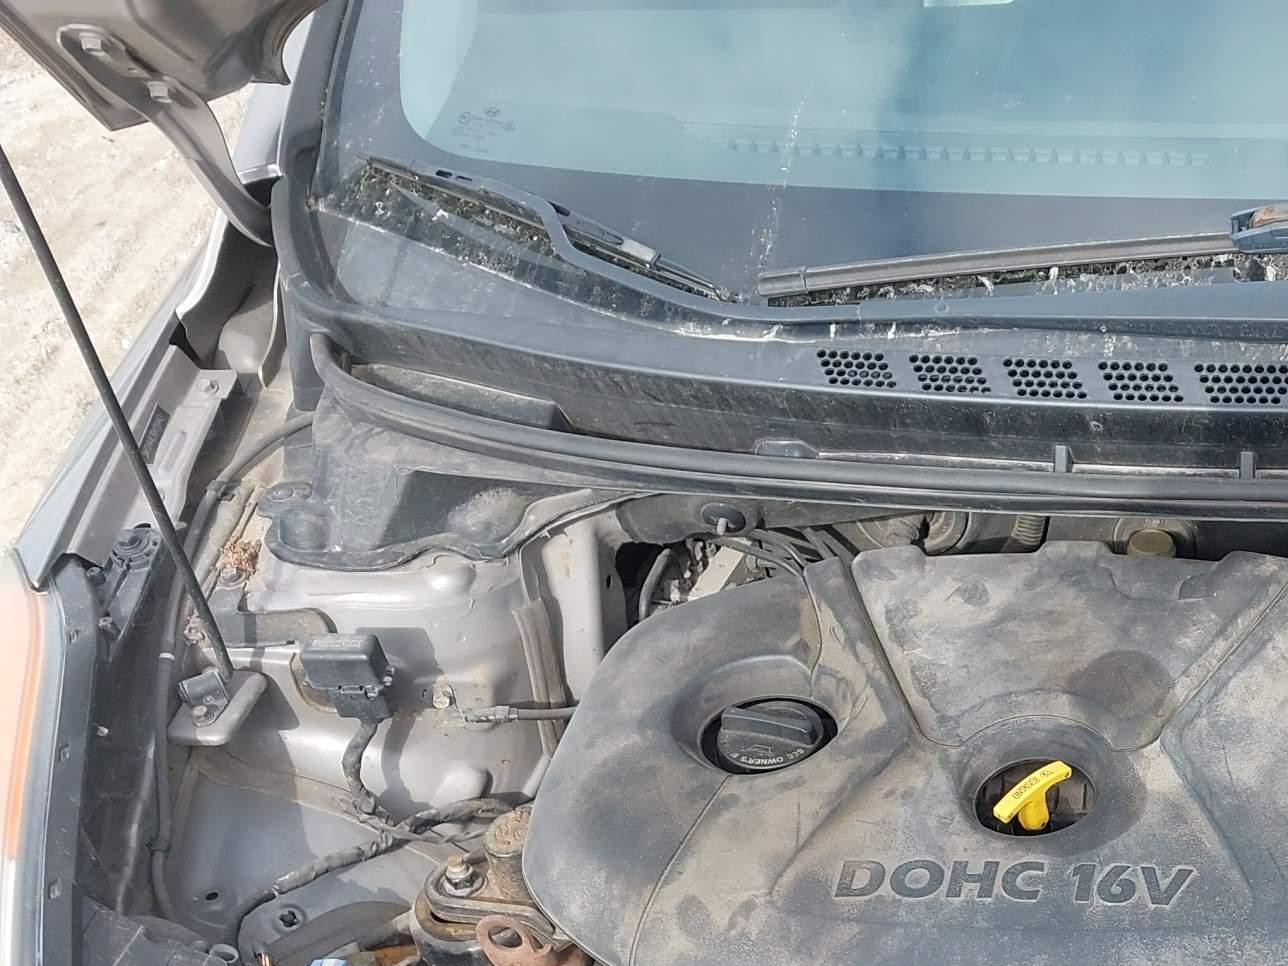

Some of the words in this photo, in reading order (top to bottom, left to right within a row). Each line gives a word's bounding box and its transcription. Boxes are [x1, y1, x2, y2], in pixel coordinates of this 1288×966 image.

[739, 755, 784, 765] OWNER'S
[833, 859, 1047, 900] DOHC
[1071, 863, 1196, 907] 16V
